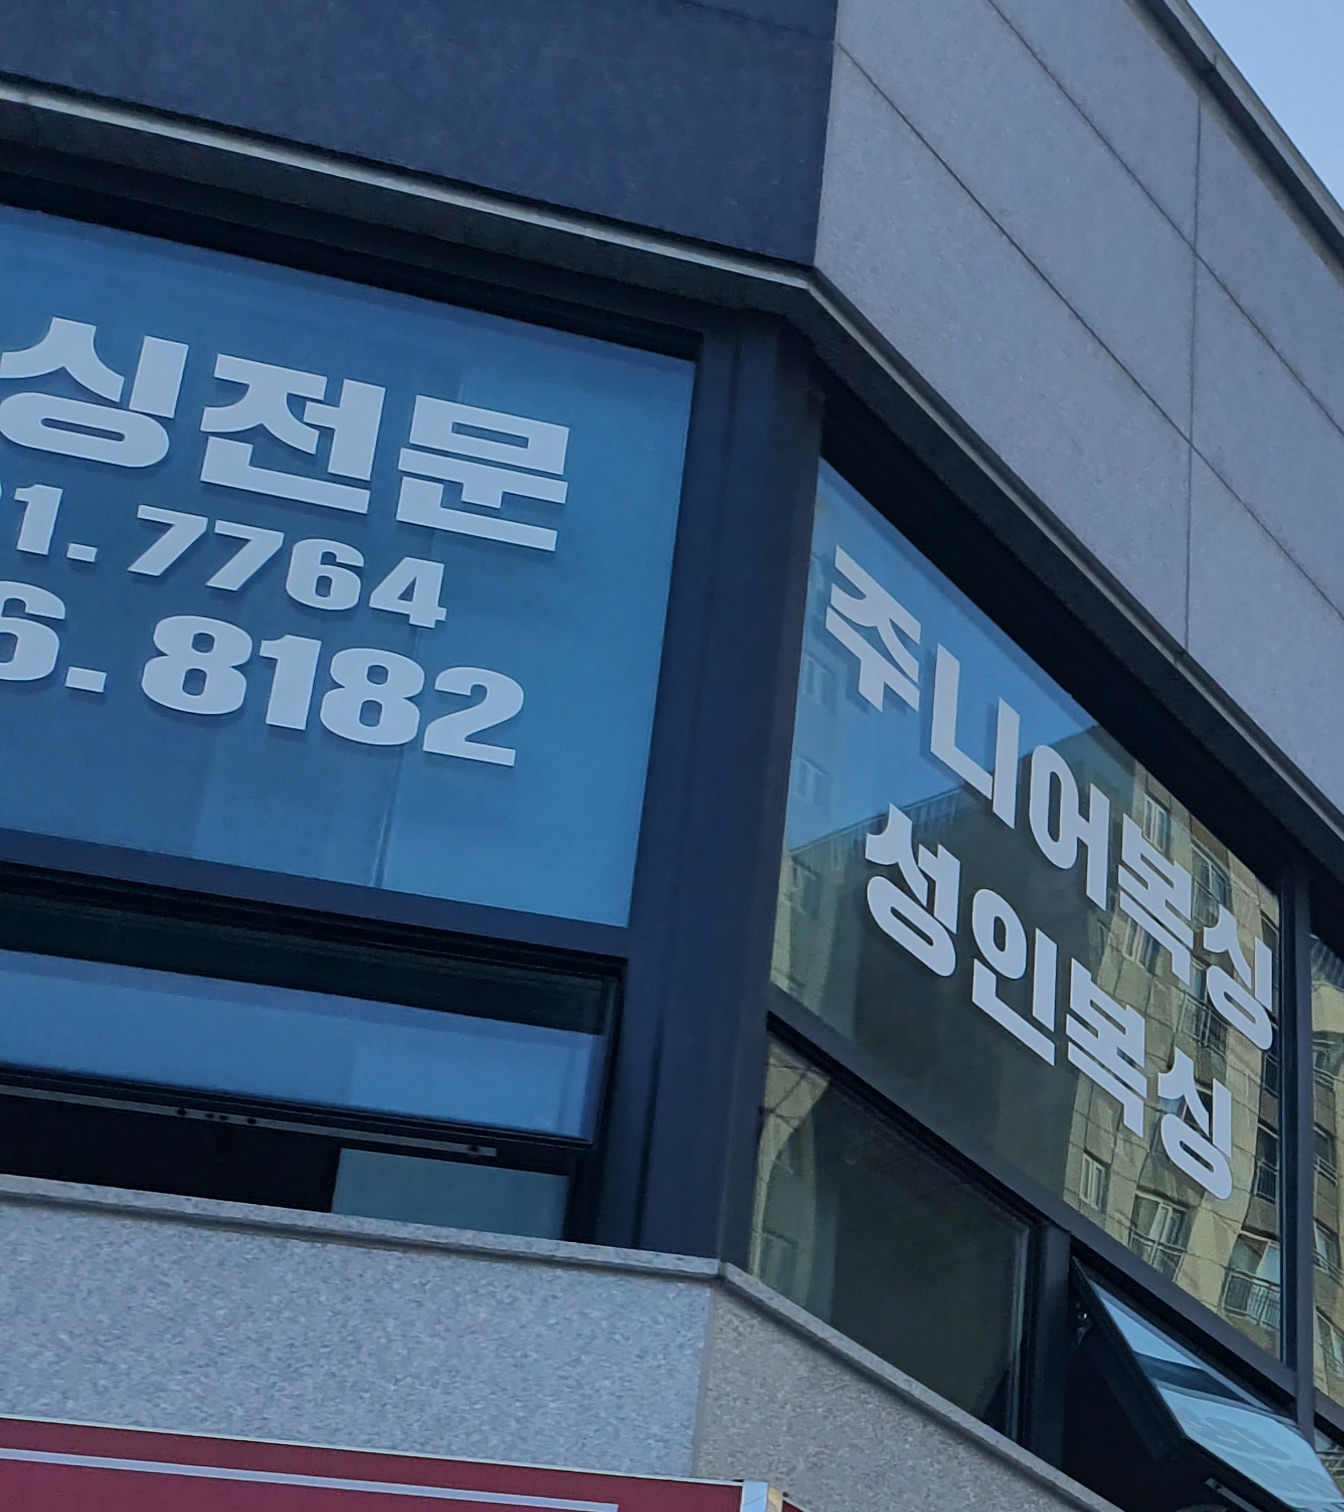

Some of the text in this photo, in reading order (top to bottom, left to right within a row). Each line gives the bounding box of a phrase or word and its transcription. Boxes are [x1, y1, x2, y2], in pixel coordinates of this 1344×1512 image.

[0, 317, 569, 552] 싱전문
[0, 483, 447, 628] 1.7764
[825, 545, 1274, 1052] 주니어복싱
[866, 803, 1234, 1200] 성인복싱
